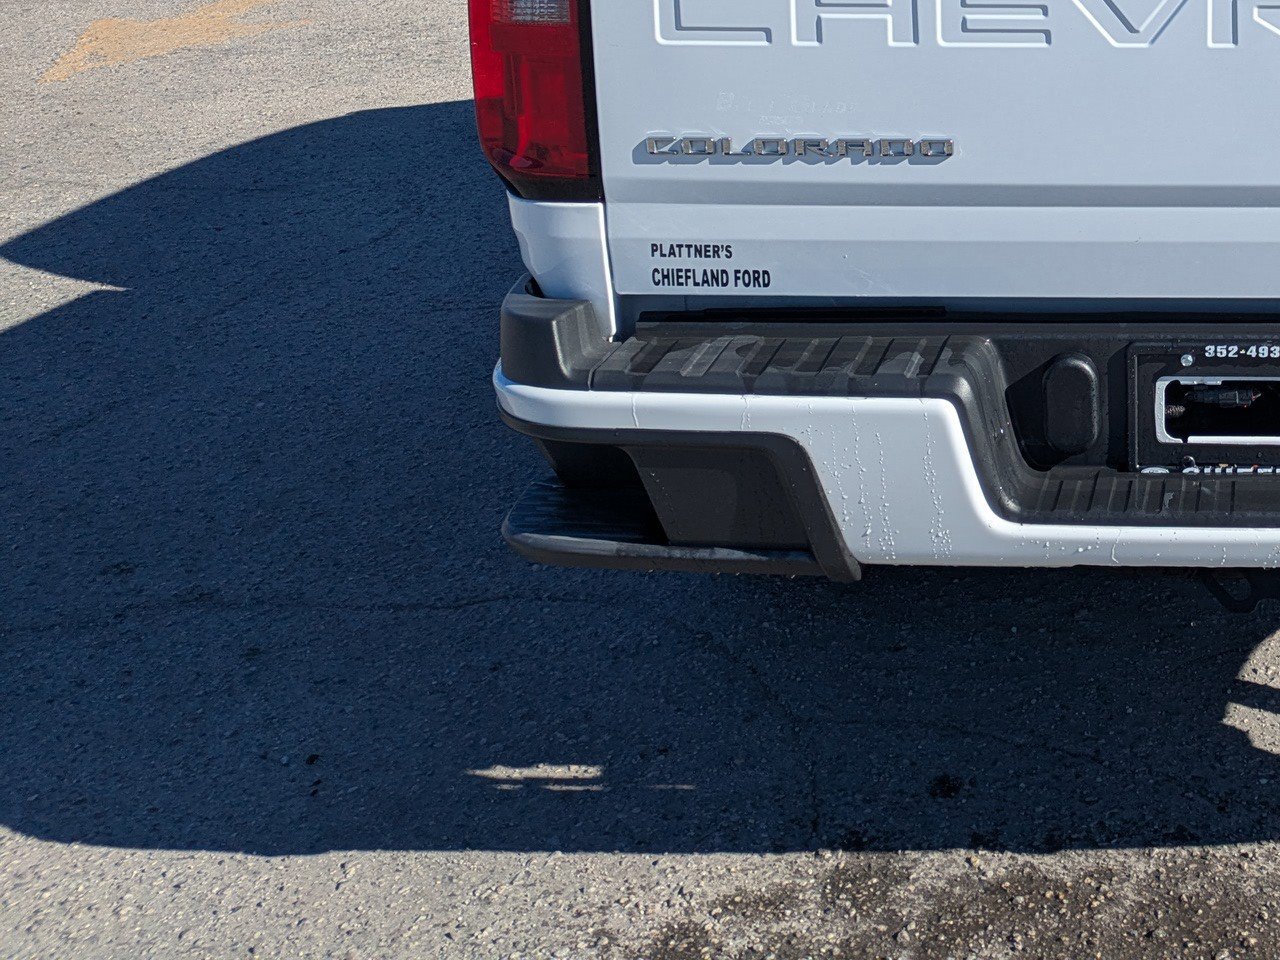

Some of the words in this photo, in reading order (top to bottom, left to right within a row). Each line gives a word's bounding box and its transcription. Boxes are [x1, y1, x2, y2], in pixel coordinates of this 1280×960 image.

[640, 134, 954, 160] COLORADO
[650, 243, 733, 259] PLATTNER'S
[651, 268, 729, 288] CHIEFLAND
[733, 269, 771, 288] FORD
